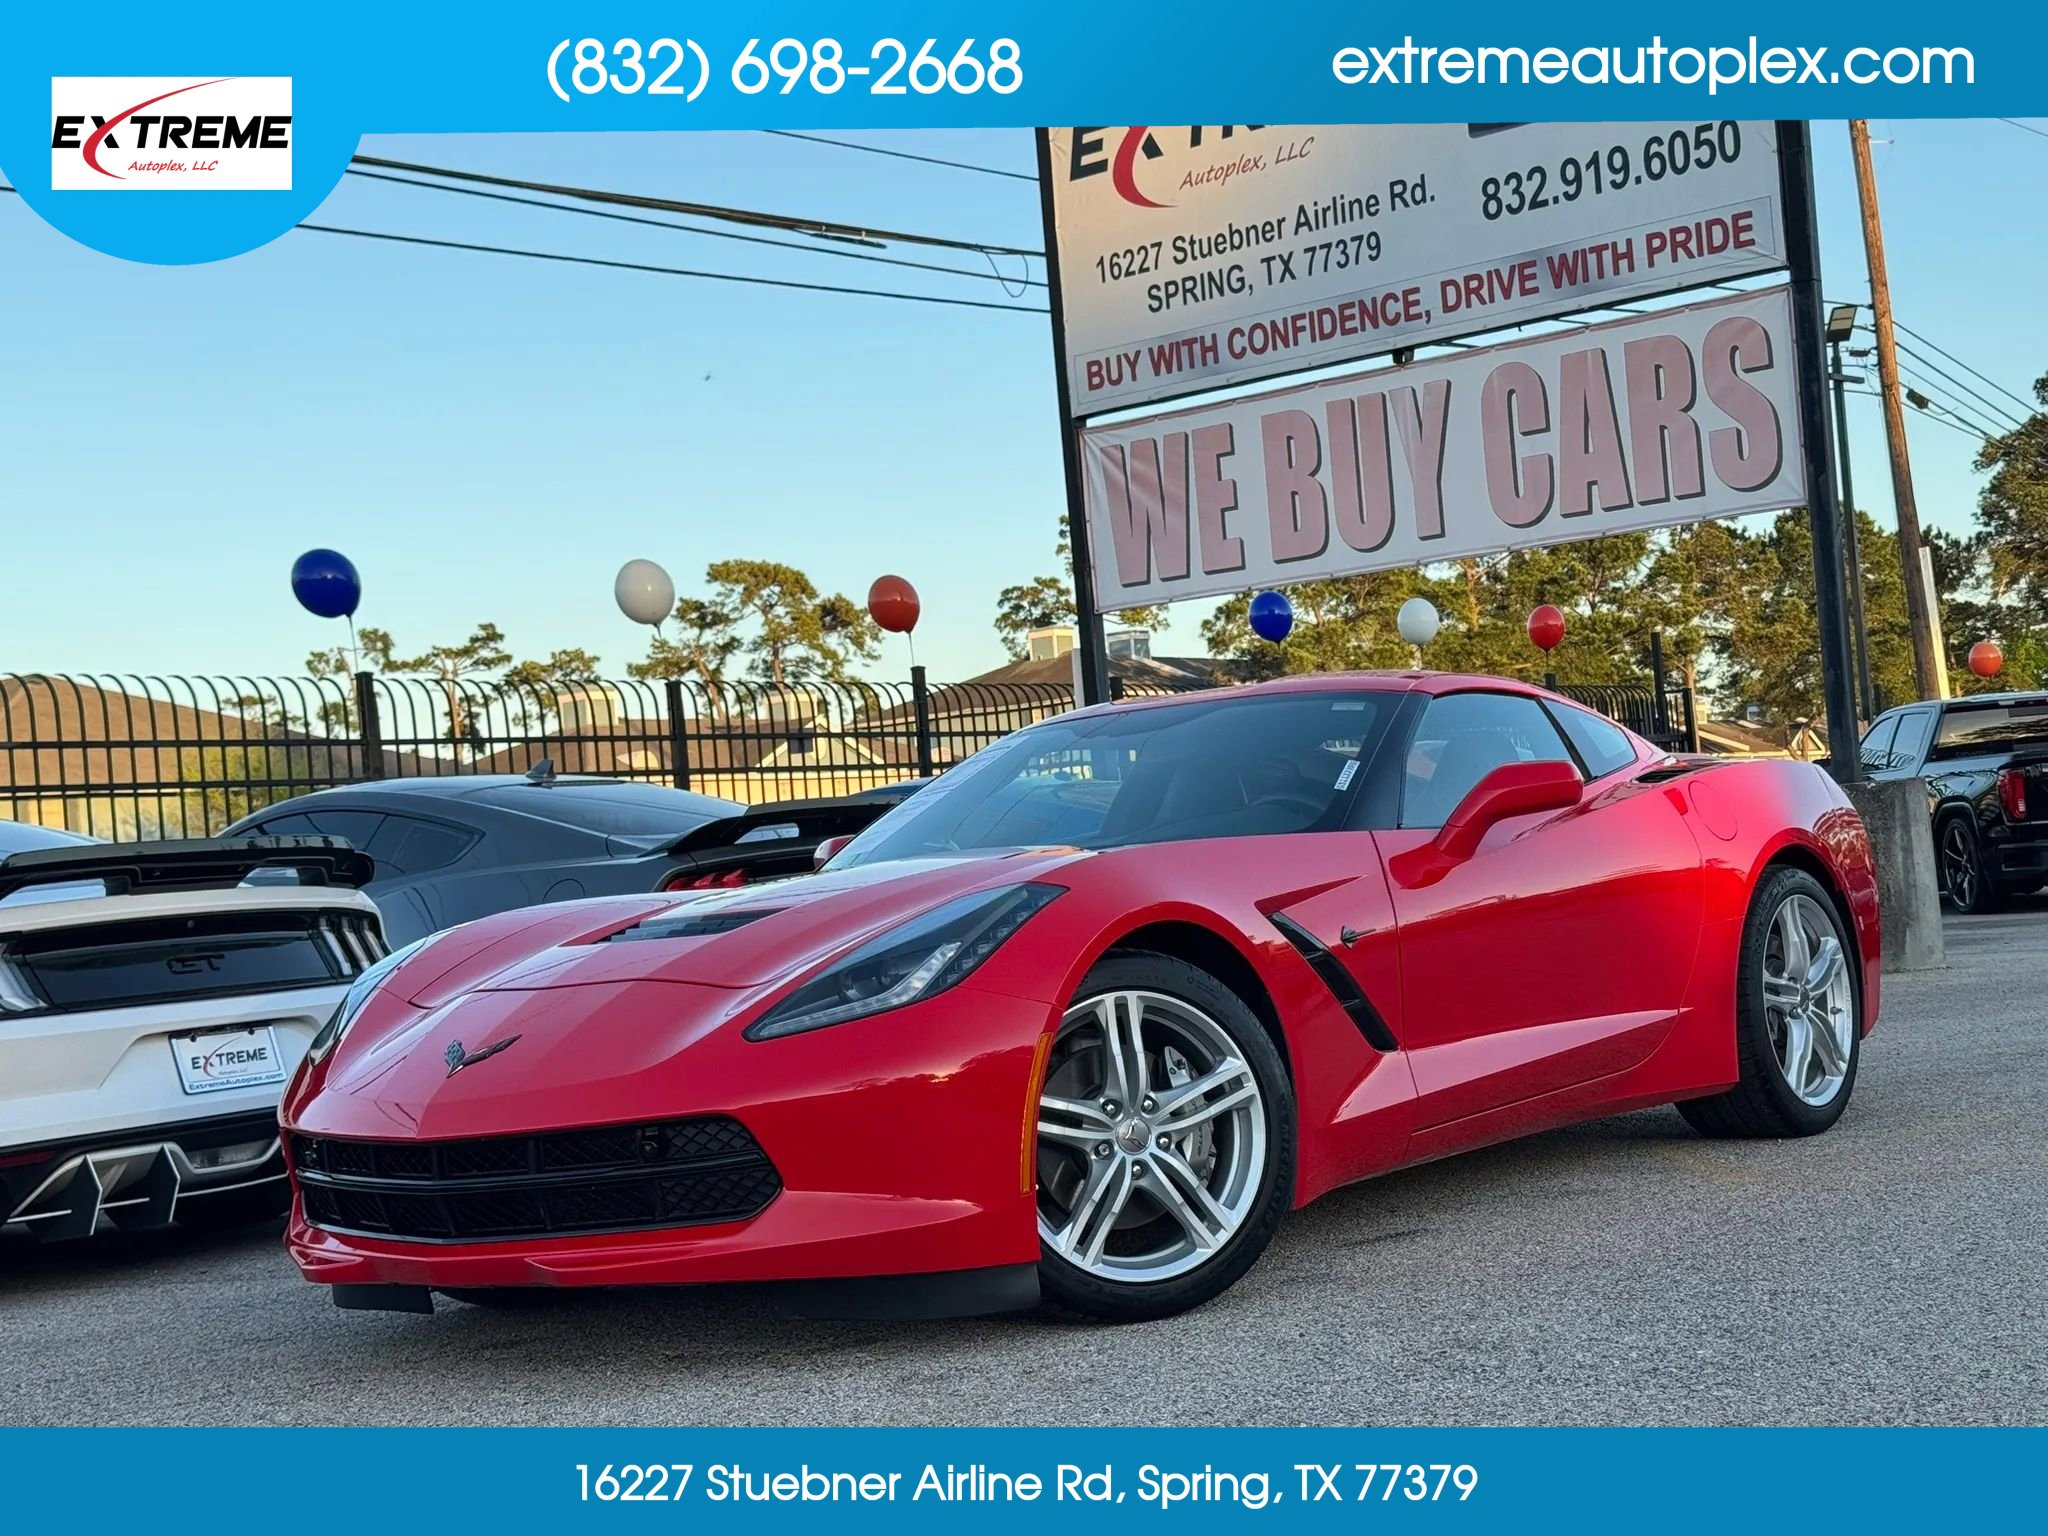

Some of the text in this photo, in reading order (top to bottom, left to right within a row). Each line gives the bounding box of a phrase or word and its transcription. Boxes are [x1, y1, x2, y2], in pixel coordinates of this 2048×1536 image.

[1179, 153, 1267, 190] Autoplex,
[1275, 136, 1315, 165] LLC
[1481, 119, 1742, 221] 832.919.6050
[1095, 173, 1436, 284] 16227 Stuebner Airline Rd.
[1147, 231, 1382, 314] SPRING, TX 77379
[1086, 210, 1756, 392] BUY WITH CONFIDENCE, DRIVE WITH PRIDE
[1101, 316, 1784, 588] WE BUY CARS
[166, 953, 225, 975] GT
[191, 1047, 268, 1070] EXTREME
